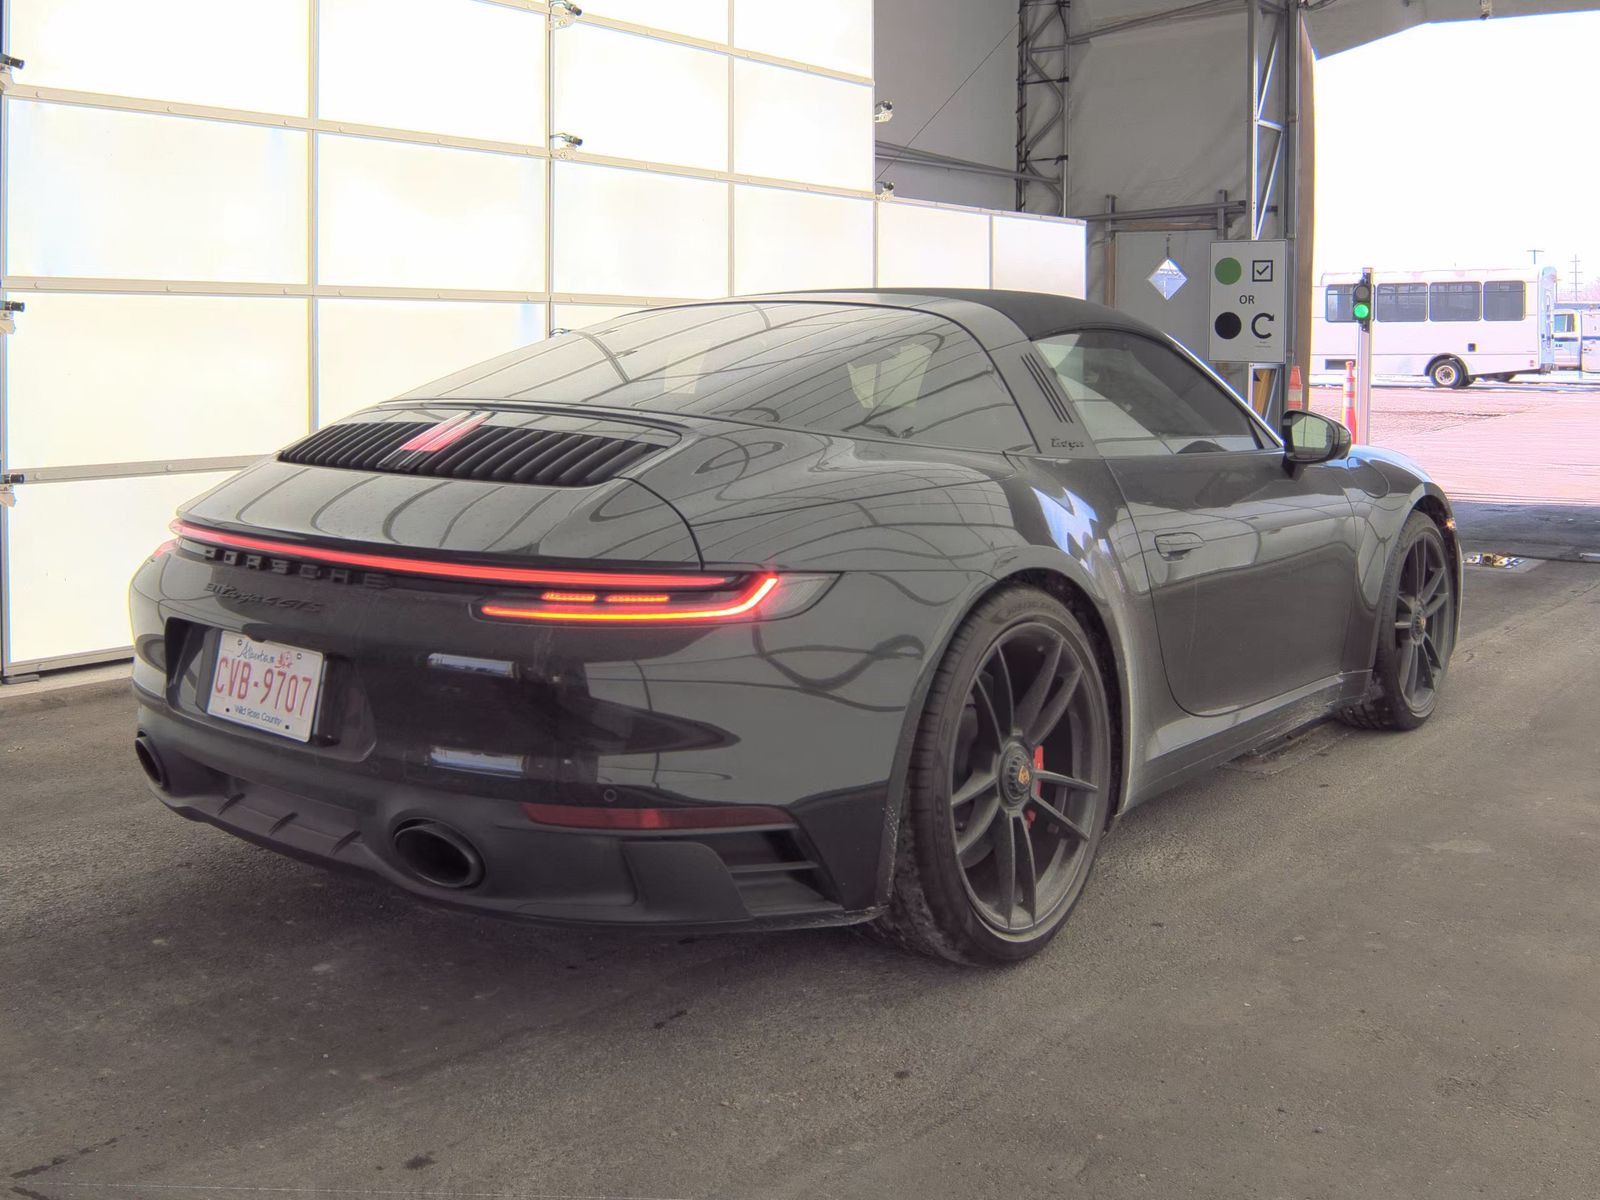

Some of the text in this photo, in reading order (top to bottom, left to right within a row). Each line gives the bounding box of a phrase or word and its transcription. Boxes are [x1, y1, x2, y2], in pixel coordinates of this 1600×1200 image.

[1239, 294, 1255, 305] OR
[204, 547, 388, 590] PORSCHE
[237, 641, 270, 663] Alberta
[215, 656, 313, 718] CVB-9707
[234, 704, 283, 727] Wild Rose Country
